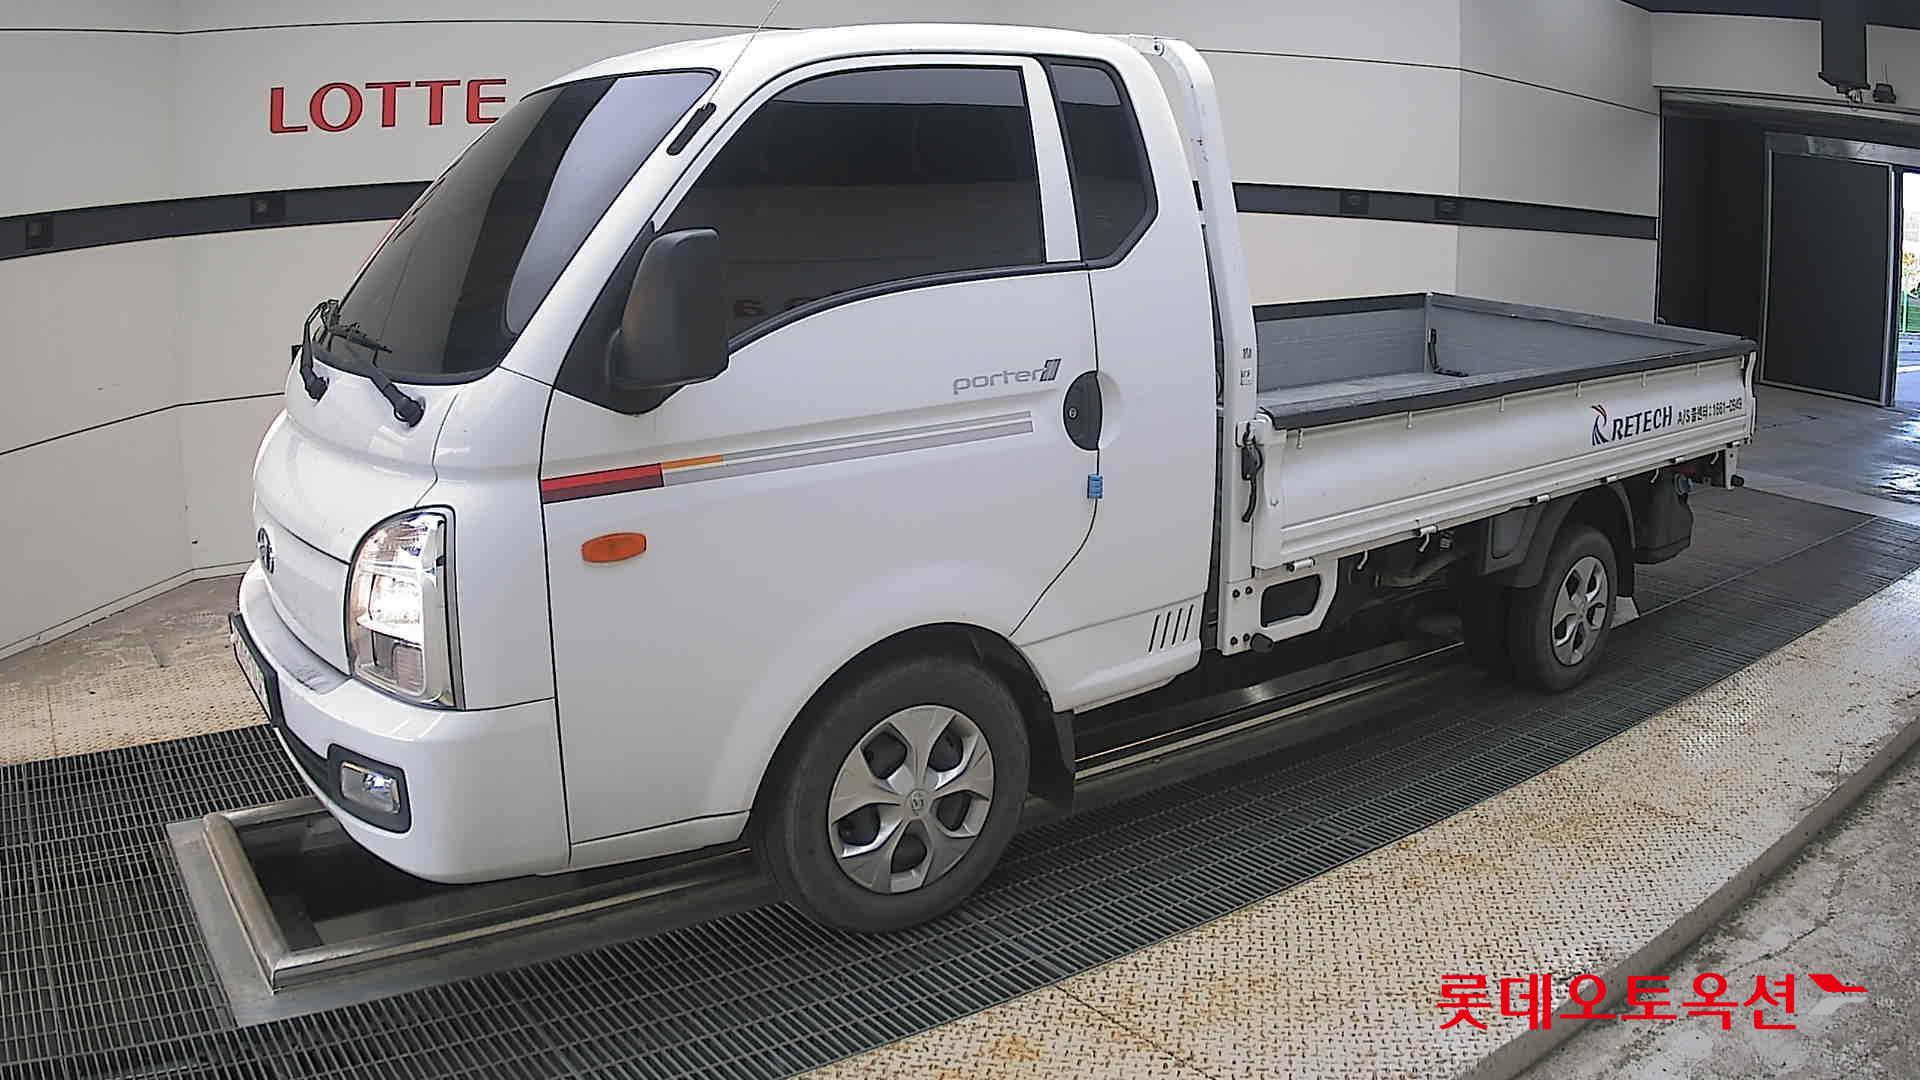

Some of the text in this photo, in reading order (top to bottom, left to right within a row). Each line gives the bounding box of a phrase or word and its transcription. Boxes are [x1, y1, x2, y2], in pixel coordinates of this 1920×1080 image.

[270, 79, 507, 133] LOTTE
[953, 368, 1044, 395] porter
[1611, 405, 1673, 441] RETECH
